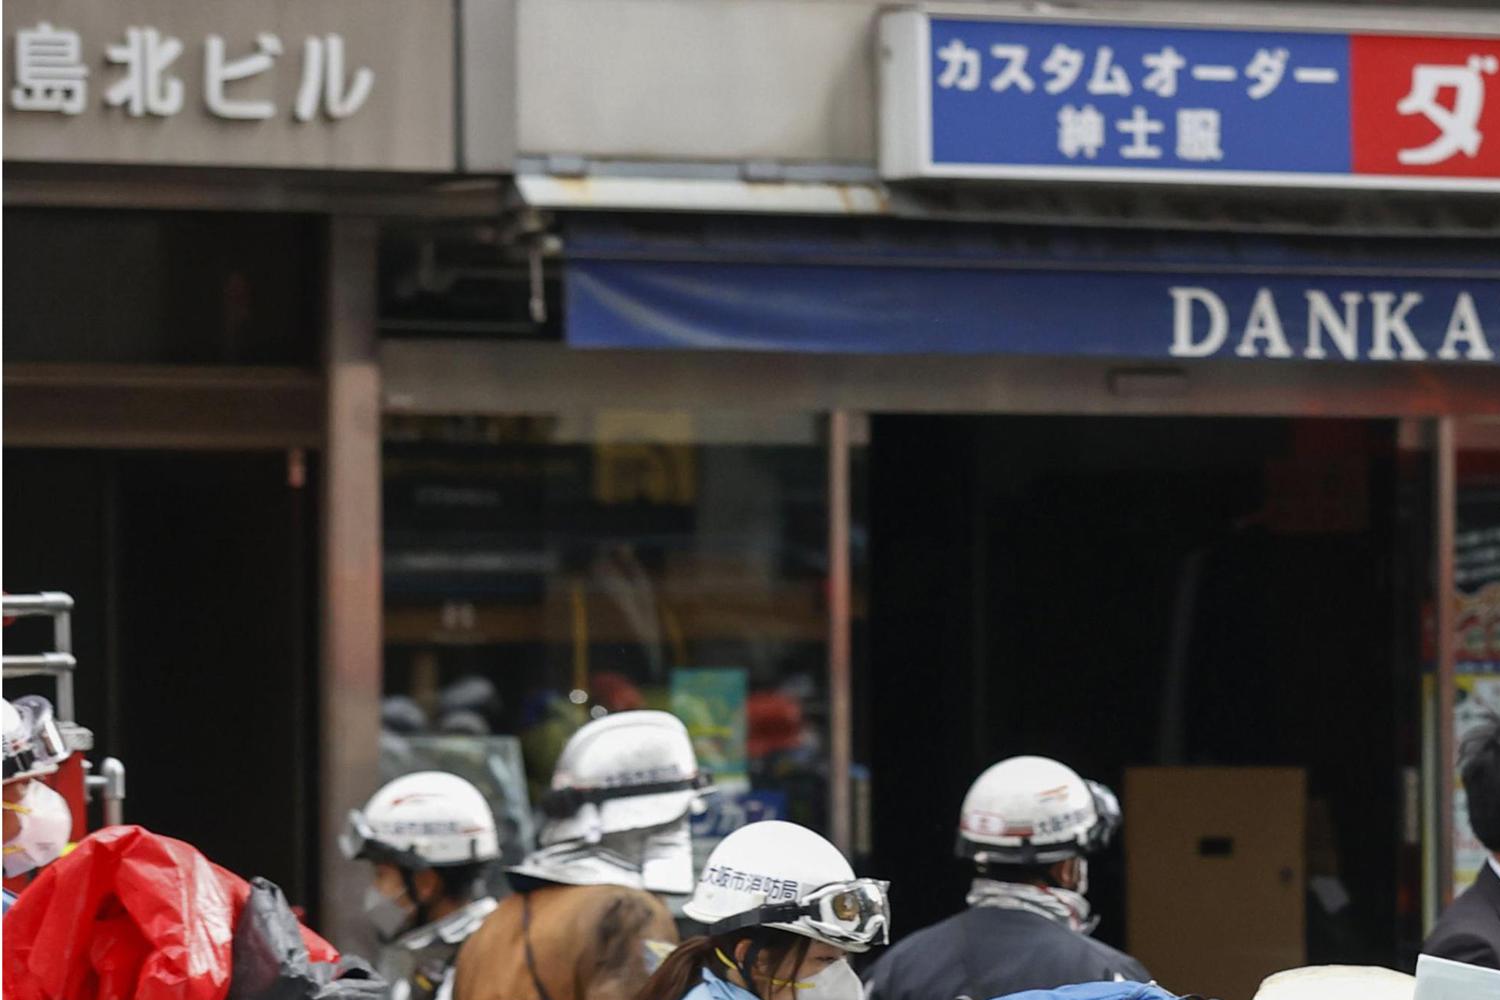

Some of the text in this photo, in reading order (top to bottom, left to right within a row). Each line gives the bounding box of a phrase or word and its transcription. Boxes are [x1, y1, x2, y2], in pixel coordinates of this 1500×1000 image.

[12, 22, 374, 120] 島北ビル
[937, 40, 1339, 98] カスタムオーダー
[1058, 106, 1223, 161] 紳士服
[700, 864, 798, 901] 大阪市消防局
